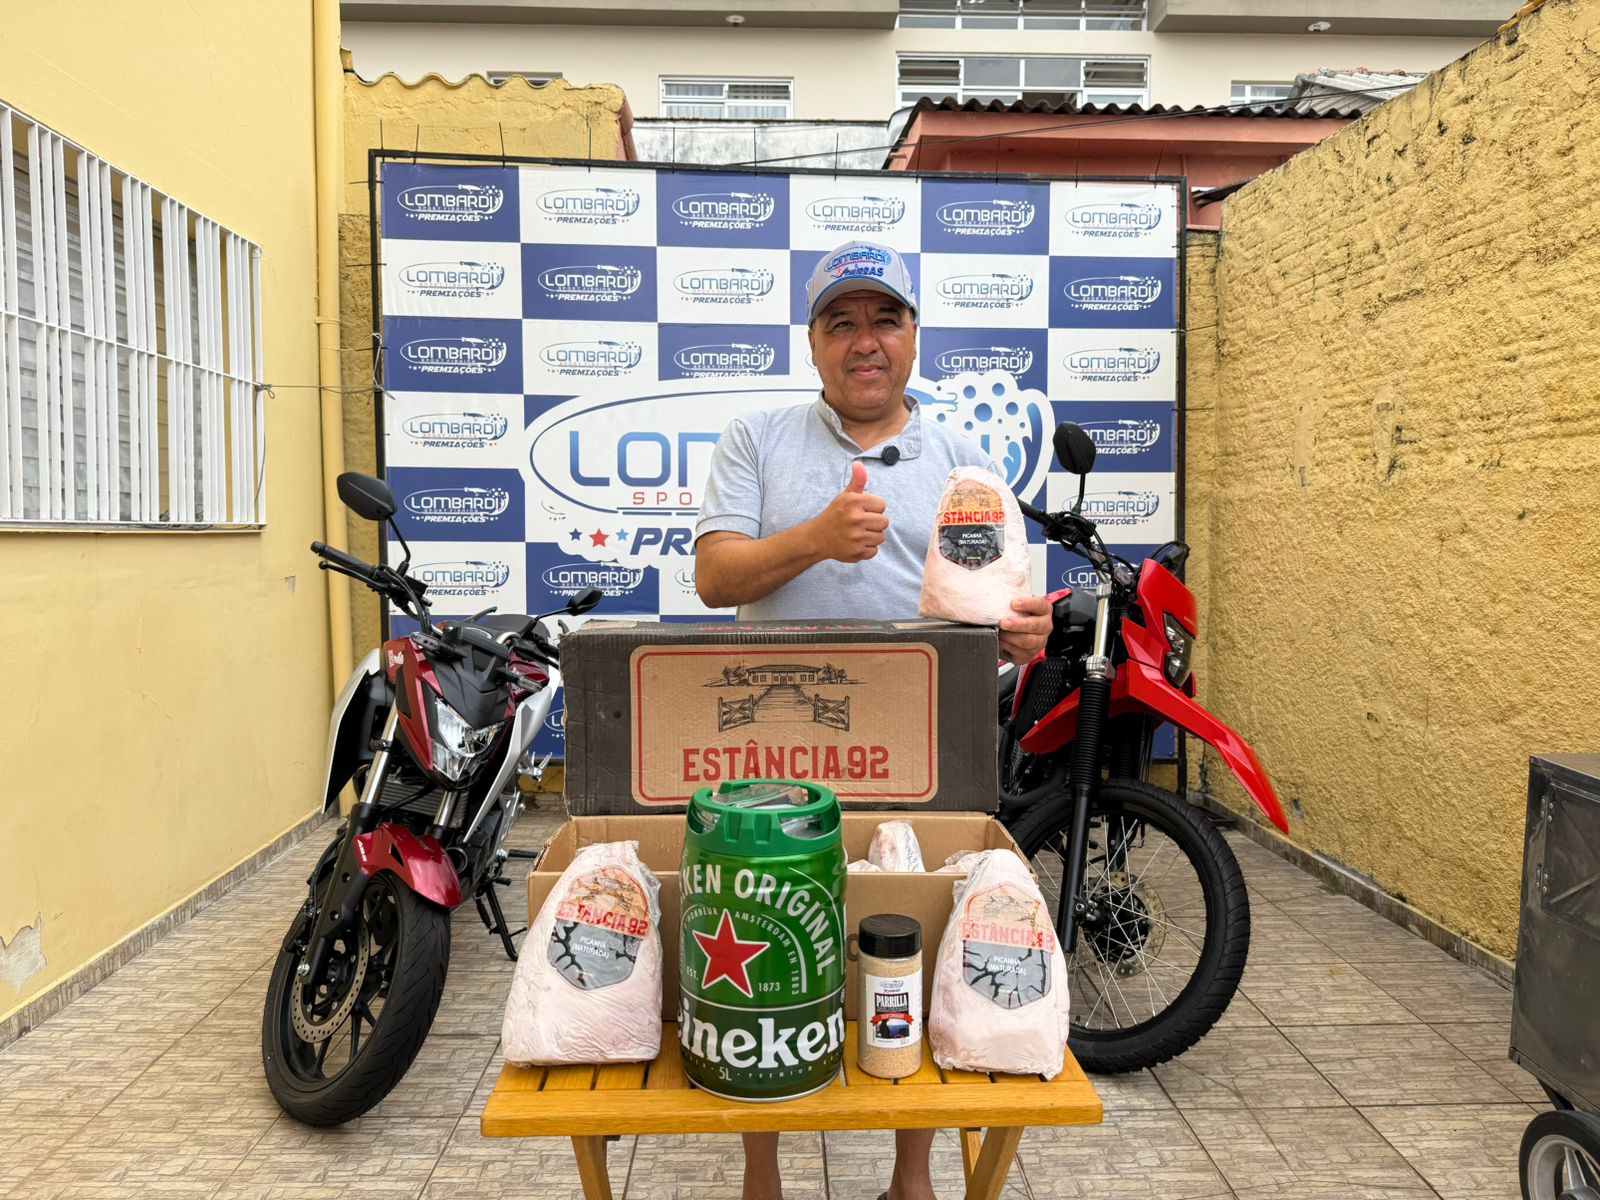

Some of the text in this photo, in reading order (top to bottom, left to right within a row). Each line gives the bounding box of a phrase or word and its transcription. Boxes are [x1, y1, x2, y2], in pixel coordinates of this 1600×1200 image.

[405, 193, 493, 208] LOMBARDI
[544, 197, 630, 211] LOMBARDI
[680, 201, 764, 216] LOMBARDI
[813, 205, 895, 219] LOMBARDI
[944, 208, 1025, 222] LOMBARDI
[418, 213, 481, 222] PREMIAÇÕES
[557, 216, 618, 225] PREMIAÇÕES
[1072, 212, 1152, 225] LOMBARDI
[692, 220, 752, 230] PREMIAÇÕES
[825, 223, 884, 233] PREMIAÇÕES
[955, 227, 1014, 236] PREMIAÇÕES
[1083, 229, 1140, 239] PREMIAÇÕES
[406, 270, 494, 284] LOMBARDI
[545, 274, 631, 288] LOMBARDI
[680, 277, 764, 291] LOMBARDI
[943, 282, 1024, 296] LOMBARDI
[420, 288, 482, 298] PREMIAÇÕES
[558, 293, 620, 302] PREMIAÇÕES
[1071, 284, 1152, 298] LOMBARDI
[693, 295, 752, 305] PREMIAÇÕES
[954, 300, 1012, 310] PREMIAÇÕES
[1082, 302, 1140, 312] PREMIAÇÕES
[408, 346, 496, 360] LOMBARDI
[547, 349, 632, 364] LOMBARDI
[681, 352, 765, 366] LOMBARDI
[942, 356, 1023, 368] LOMBARDI
[1070, 357, 1150, 370] LOMBARDI
[421, 364, 484, 374] PREMIAÇÕES
[560, 367, 620, 378] PREMIAÇÕES
[1081, 374, 1138, 383] PREMIAÇÕES
[410, 421, 498, 435] LOMBARDI
[1083, 429, 1152, 442] MBARDI
[423, 440, 486, 449] PREMIAÇÕES
[1096, 446, 1138, 455] EMIAÇÕES
[412, 496, 498, 510] LOMBARDI
[632, 492, 693, 506] SPO
[424, 515, 487, 524] PREMIAÇÕES
[1089, 518, 1138, 526] EMIAÇÕES
[550, 572, 635, 584] LOMBARDI
[426, 587, 488, 597] PREMIAÇÕES
[682, 738, 890, 783] ESTÂNCIA92
[734, 868, 836, 976] ORIGINAL
[735, 912, 791, 948] AMSTERDAM
[580, 936, 606, 948] PICANHA
[787, 950, 798, 965] EN
[994, 956, 1021, 966] PICANHA
[758, 982, 781, 992] 1873
[791, 970, 800, 996] 1883
[677, 997, 846, 1069] ineken
[719, 1066, 732, 1082] 5L
